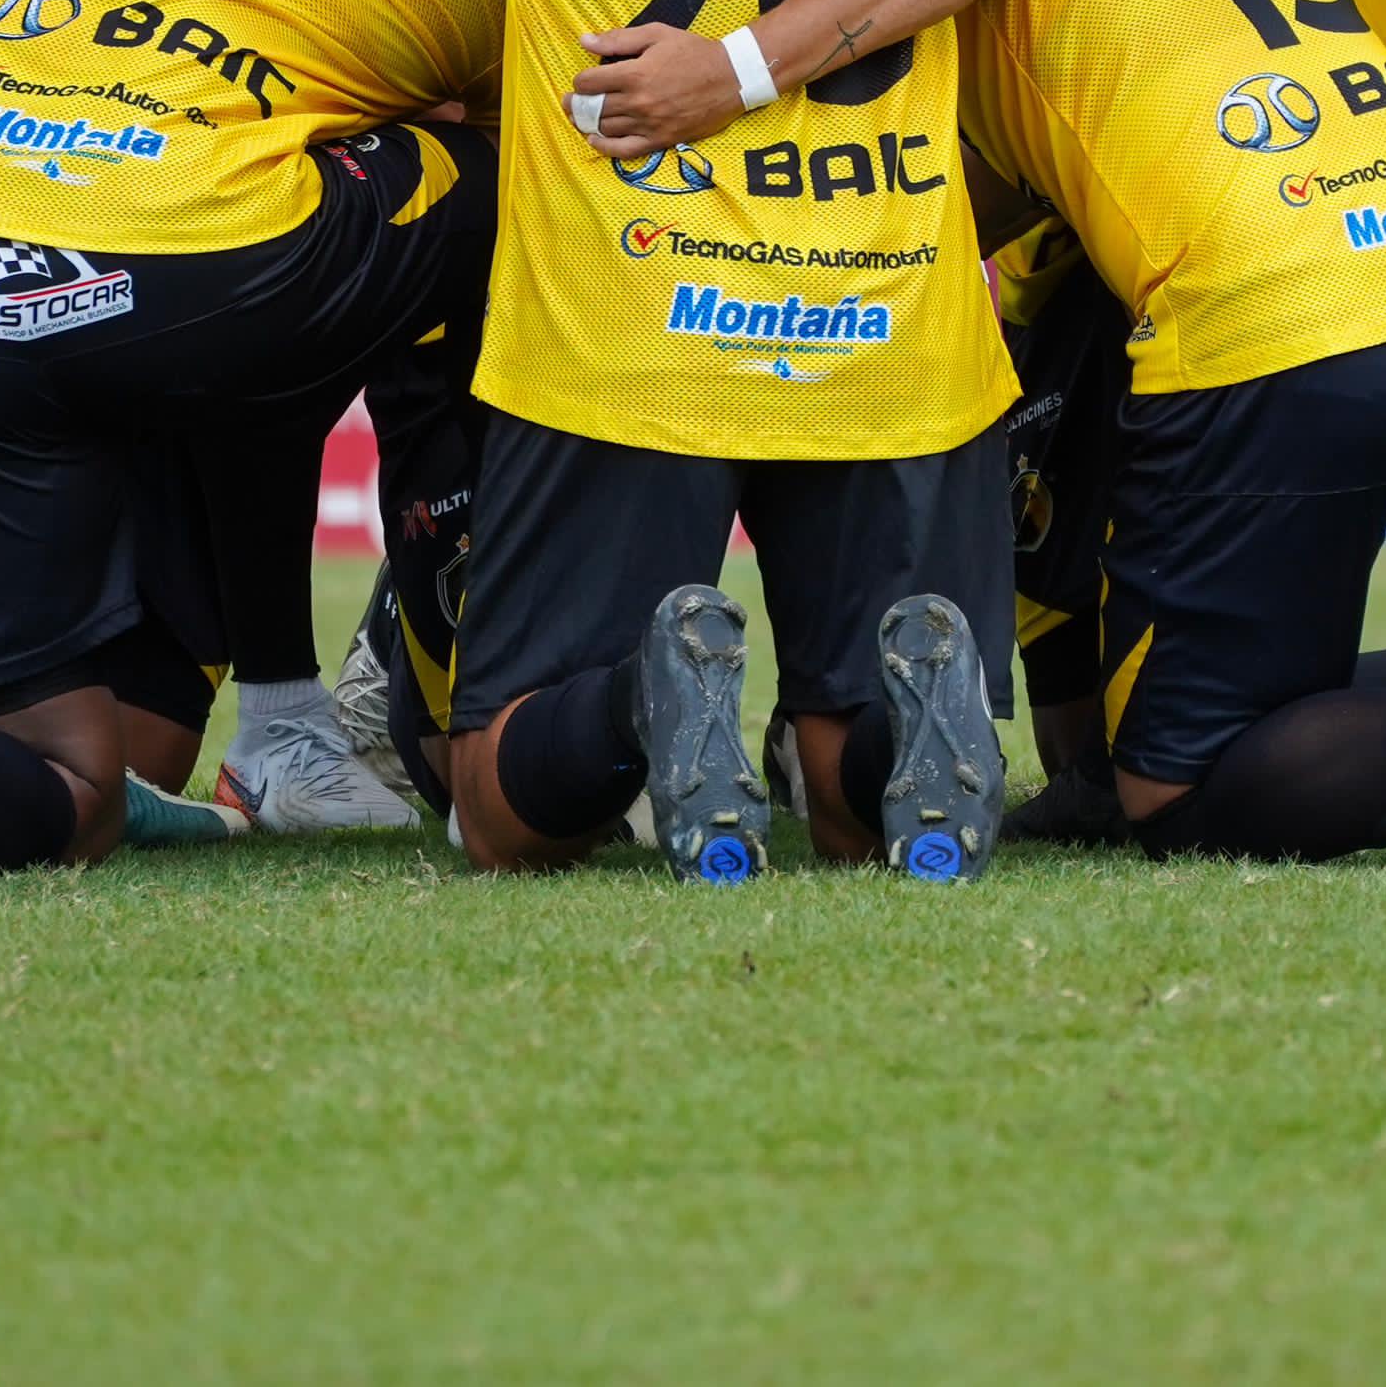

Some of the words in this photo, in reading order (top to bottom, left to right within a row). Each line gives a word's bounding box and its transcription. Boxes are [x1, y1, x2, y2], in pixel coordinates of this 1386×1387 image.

[92, 0, 297, 121] BAIC
[744, 131, 947, 202] BAIC
[667, 231, 804, 265] TecnoGAS
[807, 243, 938, 270] Automotriz
[668, 285, 889, 339] Montaña
